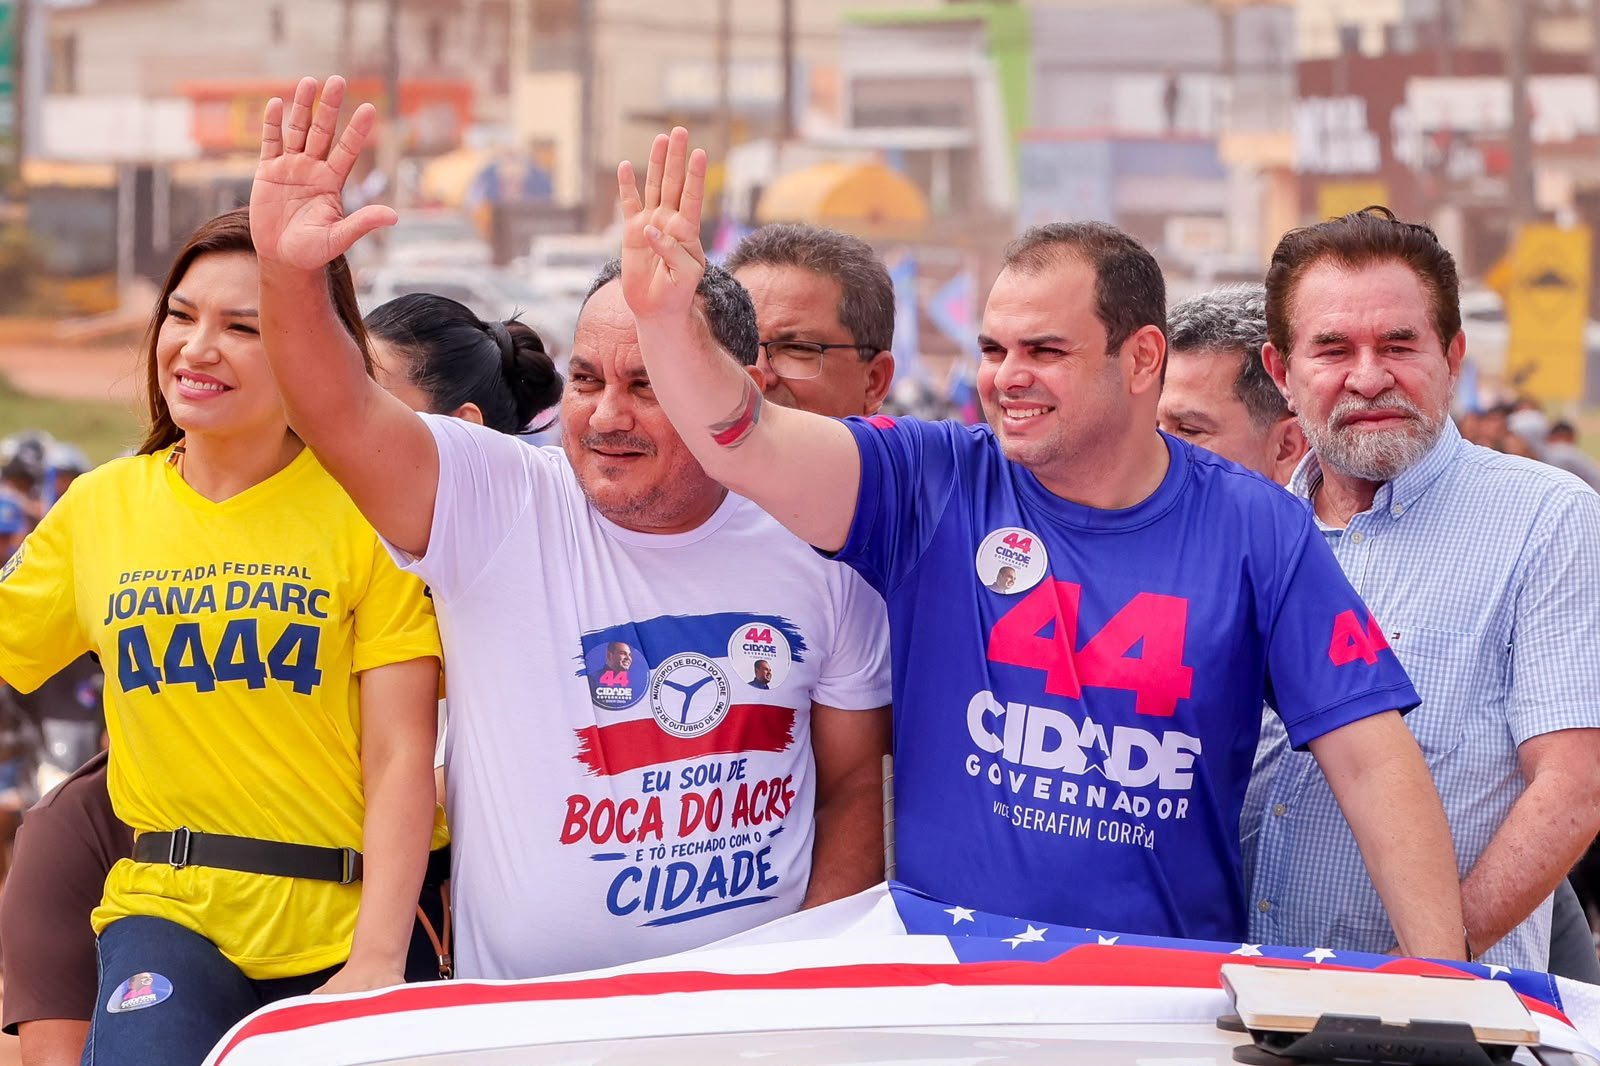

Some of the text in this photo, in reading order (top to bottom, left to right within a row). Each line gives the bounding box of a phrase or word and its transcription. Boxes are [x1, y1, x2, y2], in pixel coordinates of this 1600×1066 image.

[995, 546, 1031, 565] CIDADE
[1003, 532, 1032, 554] 44
[119, 561, 312, 585] DEPUTADA FEDERAL
[103, 580, 330, 626] JOANA DARC
[742, 643, 777, 654] CIDADE
[745, 628, 772, 644] 44
[987, 575, 1194, 717] 44
[117, 618, 322, 696] 4444
[596, 687, 632, 696] CIDADE
[599, 670, 629, 687] 44
[673, 659, 684, 668] DE
[685, 658, 707, 669] BOCA
[707, 666, 719, 676] DO
[716, 677, 726, 696] ACRE
[655, 706, 663, 714] 22
[660, 714, 670, 724] DE
[668, 721, 705, 732] OUTUBRO
[704, 715, 715, 725] DE
[966, 690, 1202, 790] CIDADE
[641, 758, 748, 793] EU SOU DE
[965, 754, 1189, 819] GOVERNADOR
[559, 774, 796, 845] BOCA DO ACRE
[993, 800, 1010, 818] VICE
[1011, 805, 1091, 839] SERAFIM
[635, 831, 762, 862] E TÔ FECHADO COM O
[606, 845, 780, 917] CIDADE
